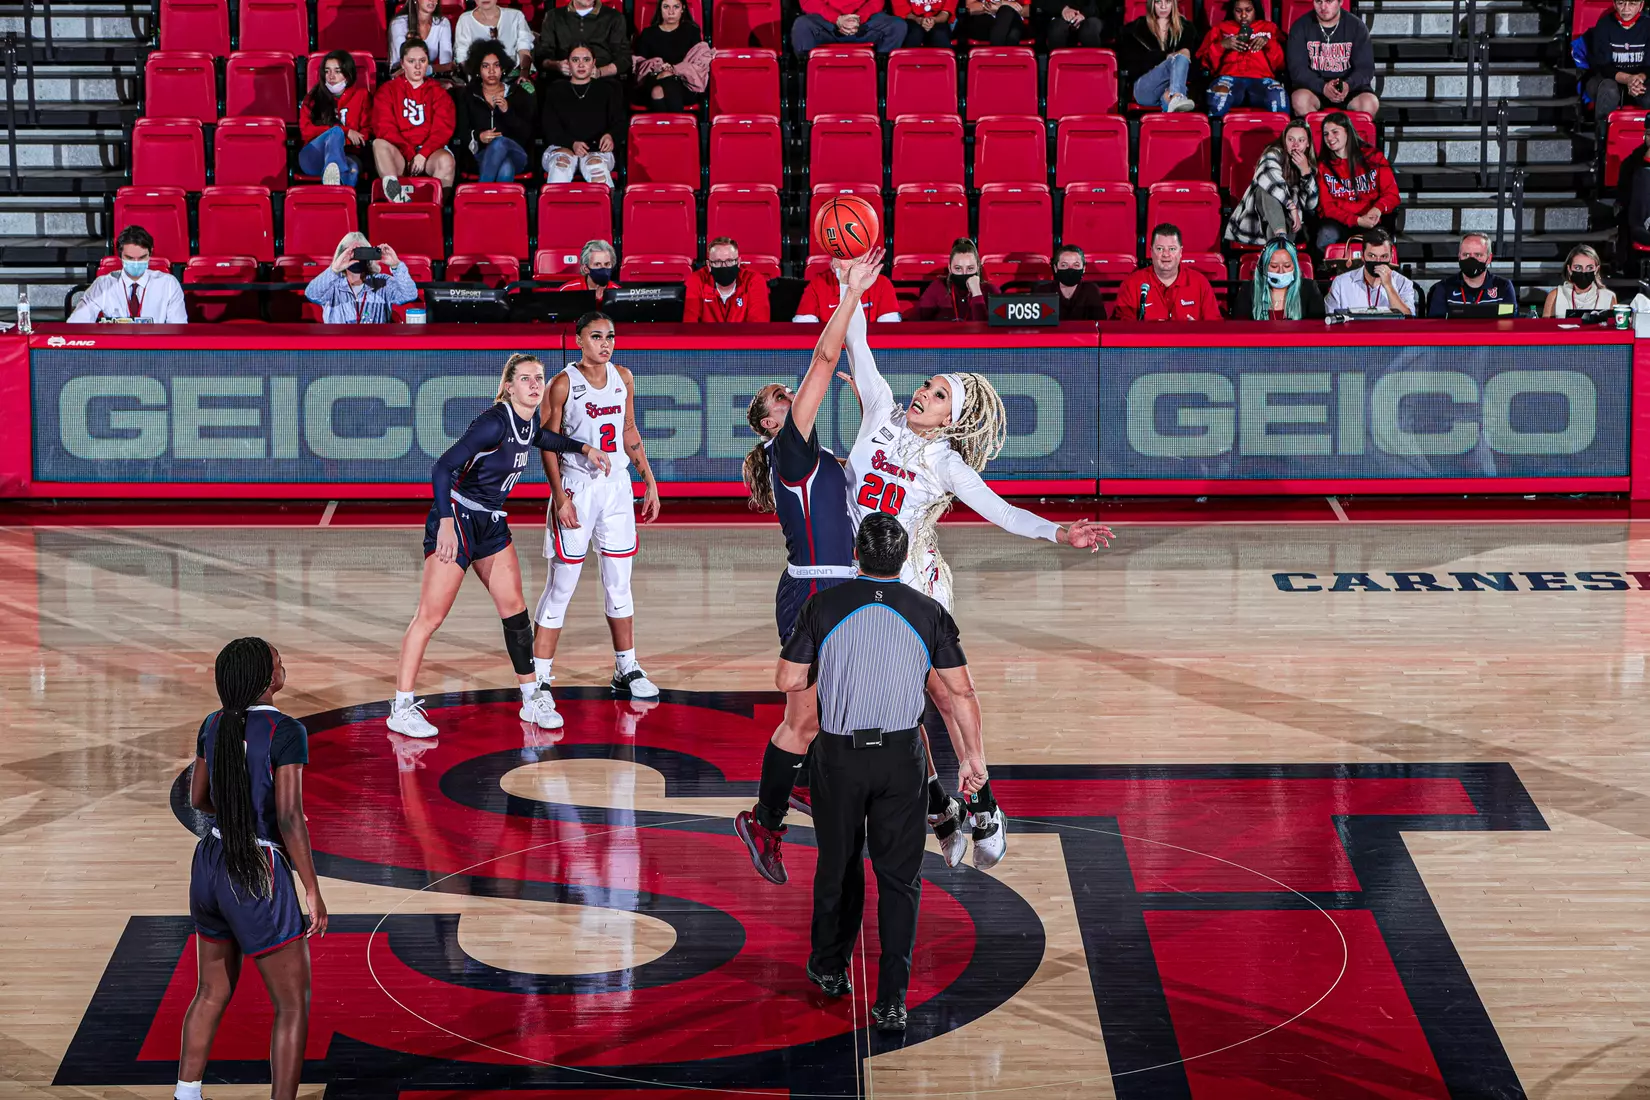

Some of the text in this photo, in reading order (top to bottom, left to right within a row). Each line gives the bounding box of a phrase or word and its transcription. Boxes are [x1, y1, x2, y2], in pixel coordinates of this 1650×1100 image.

[826, 227, 846, 257] ELITE
[1008, 303, 1040, 320] POSS
[1127, 370, 1597, 457] GEICO
[599, 423, 617, 452] 2
[857, 472, 906, 516] 20
